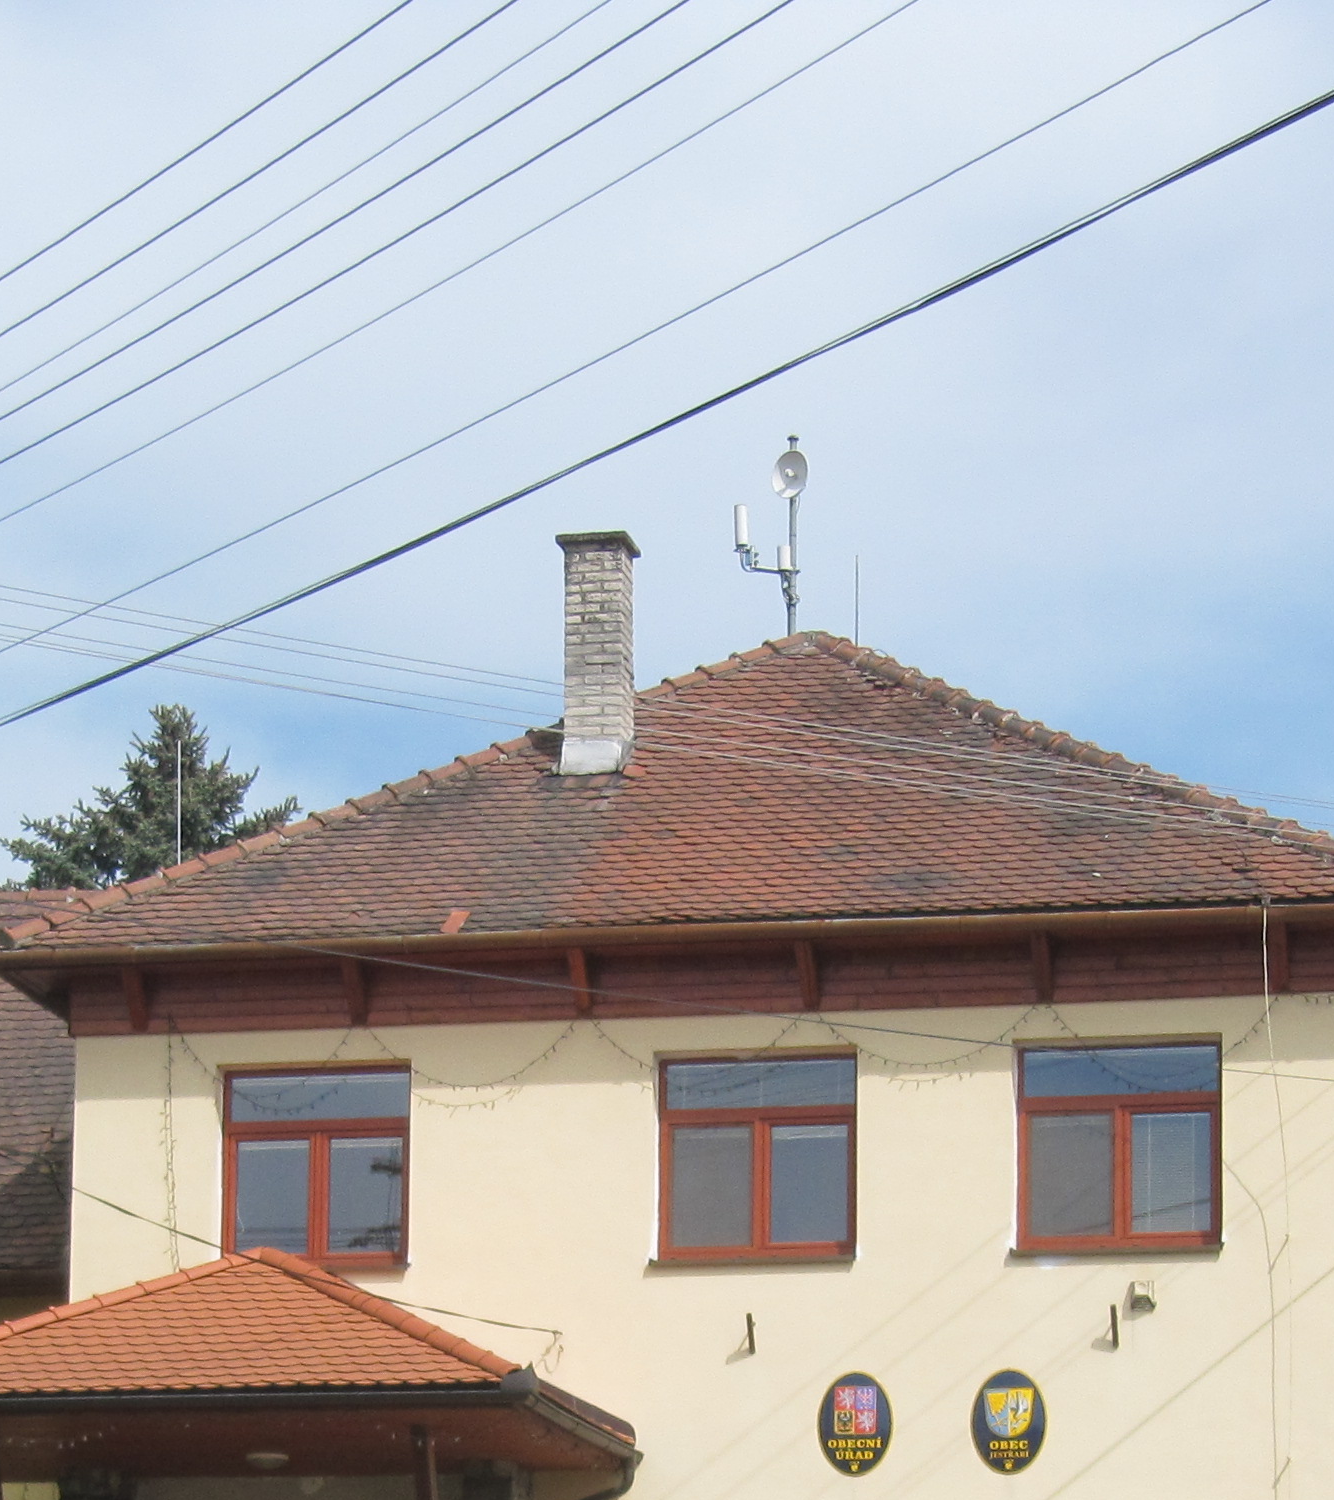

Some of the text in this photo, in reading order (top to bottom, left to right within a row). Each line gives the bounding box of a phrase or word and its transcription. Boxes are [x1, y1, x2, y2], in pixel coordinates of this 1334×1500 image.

[827, 1436, 882, 1448] OBECNÍ
[989, 1440, 1029, 1450] OBEC
[835, 1448, 875, 1460] ÚŘAD
